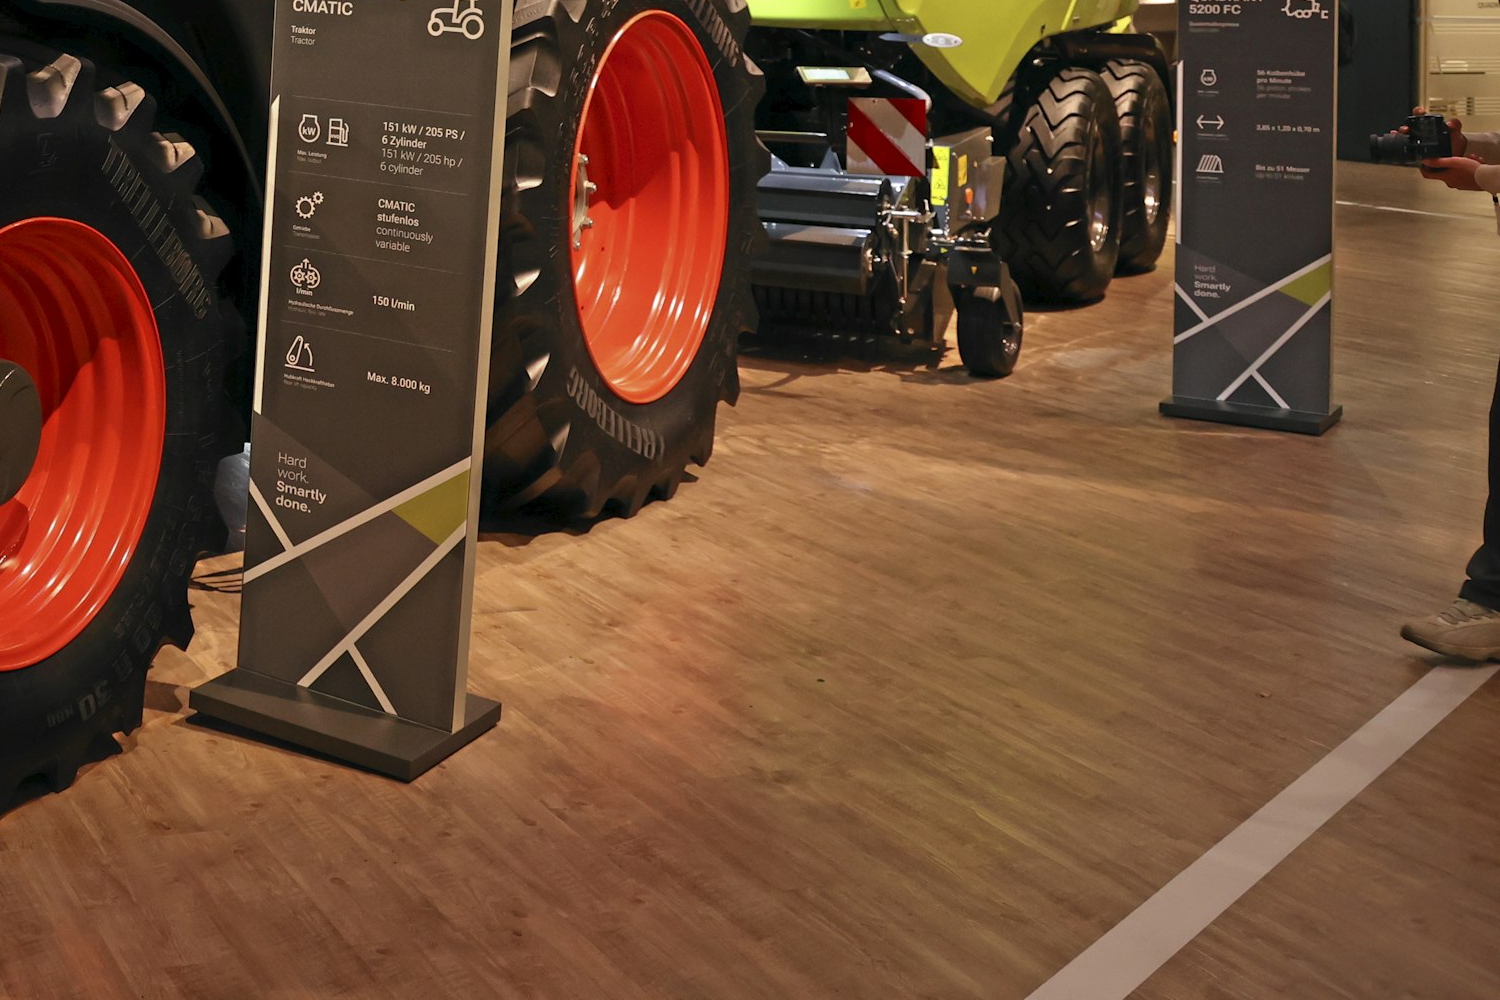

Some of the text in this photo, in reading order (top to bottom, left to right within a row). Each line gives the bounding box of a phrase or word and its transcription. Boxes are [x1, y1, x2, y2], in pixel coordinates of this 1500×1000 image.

[1189, 4, 1242, 15] 5200 FC
[290, 25, 316, 35] Traktor
[290, 35, 315, 46] Tractor
[382, 122, 466, 141] 151 kW / 205 PS /
[381, 135, 427, 149] 6 Zylinder
[381, 148, 463, 169] 151 kW / 205 hp /
[380, 162, 424, 176] 6 cylinder
[378, 199, 416, 213] CMATIC
[377, 213, 420, 227] stufenlos
[376, 226, 434, 245] continuously
[375, 240, 411, 253] variable
[1194, 265, 1216, 273] Hard
[1194, 280, 1231, 292] Smartly
[1194, 289, 1220, 299] done.
[372, 295, 415, 312] 150 l/min
[367, 371, 431, 394] Max. 8.000 kg
[278, 452, 307, 469] Hard
[277, 468, 309, 484] work.
[276, 481, 327, 504] Smartly
[275, 495, 311, 514] done.
